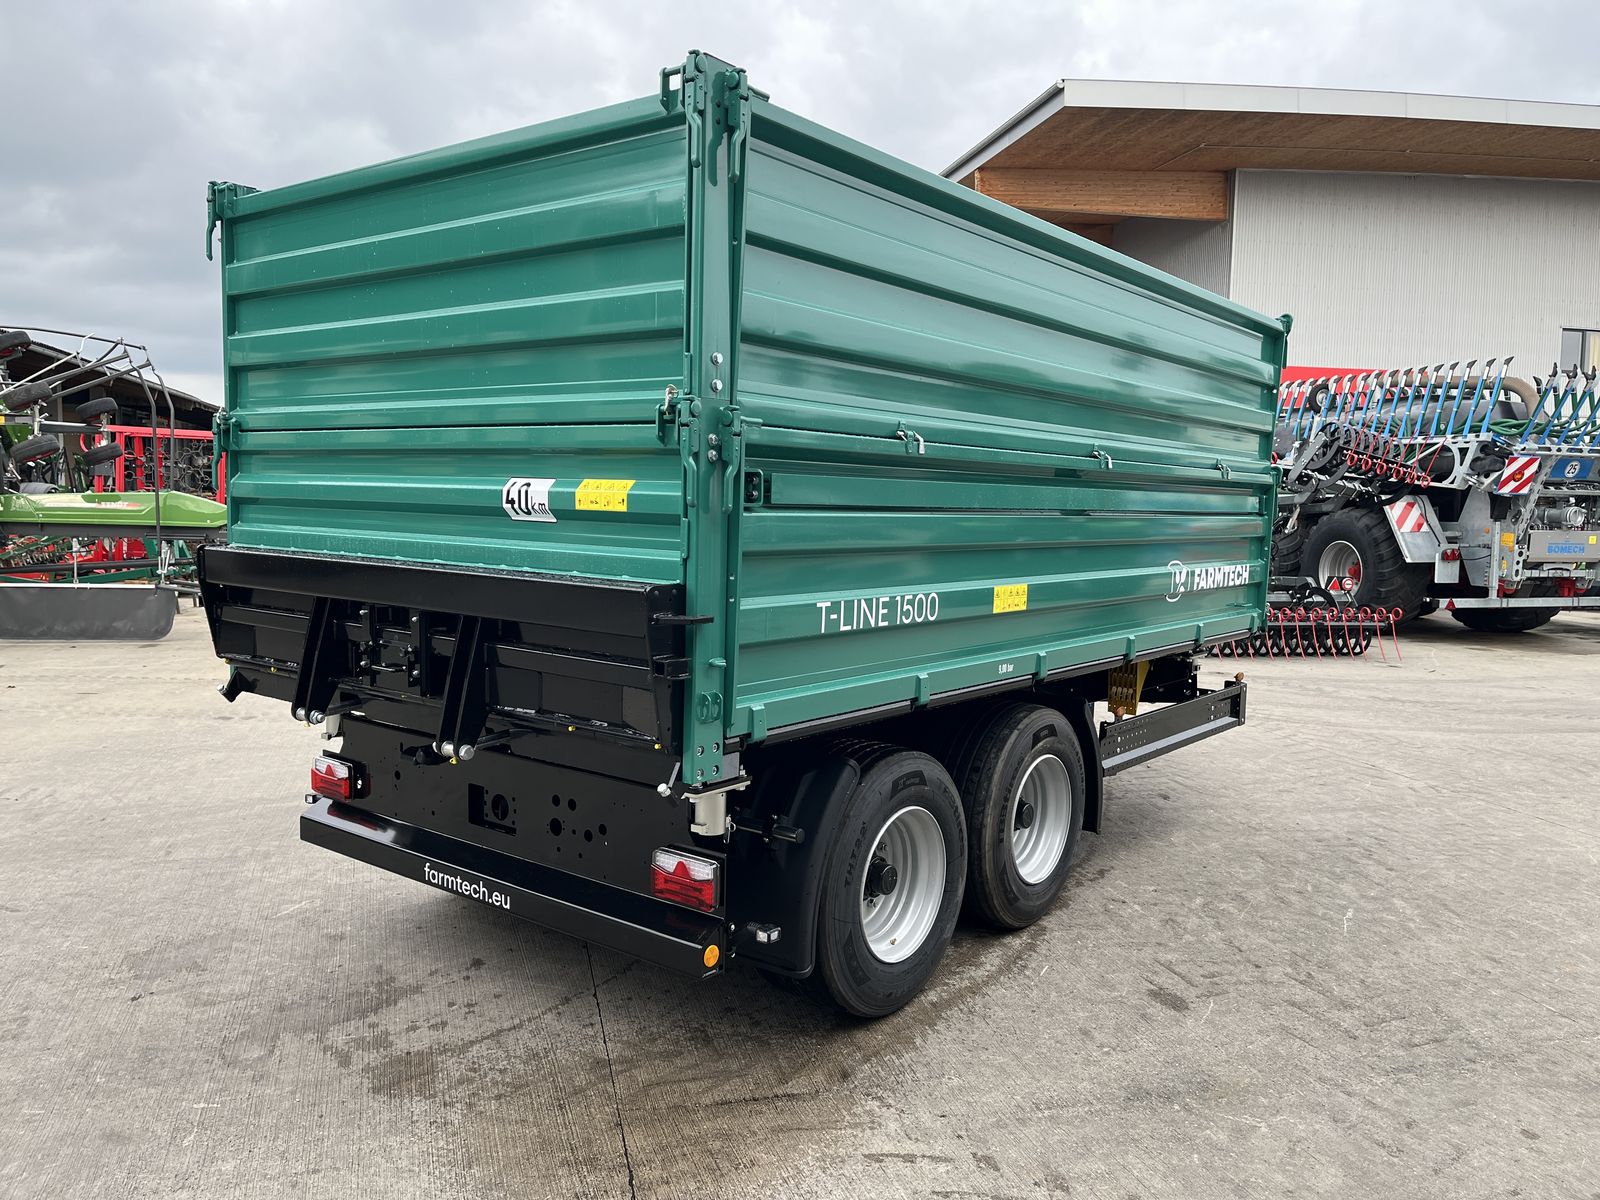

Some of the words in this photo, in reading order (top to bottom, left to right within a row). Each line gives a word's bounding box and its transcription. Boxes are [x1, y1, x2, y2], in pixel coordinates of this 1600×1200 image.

[1567, 464, 1578, 474] 25
[505, 481, 532, 516] 40
[531, 496, 550, 515] km
[1547, 544, 1585, 554] BOMECH
[1193, 564, 1250, 591] FARMTECH
[816, 596, 890, 633] T-LINE
[895, 592, 939, 625] 1500
[423, 862, 511, 910] farmtech.eu
